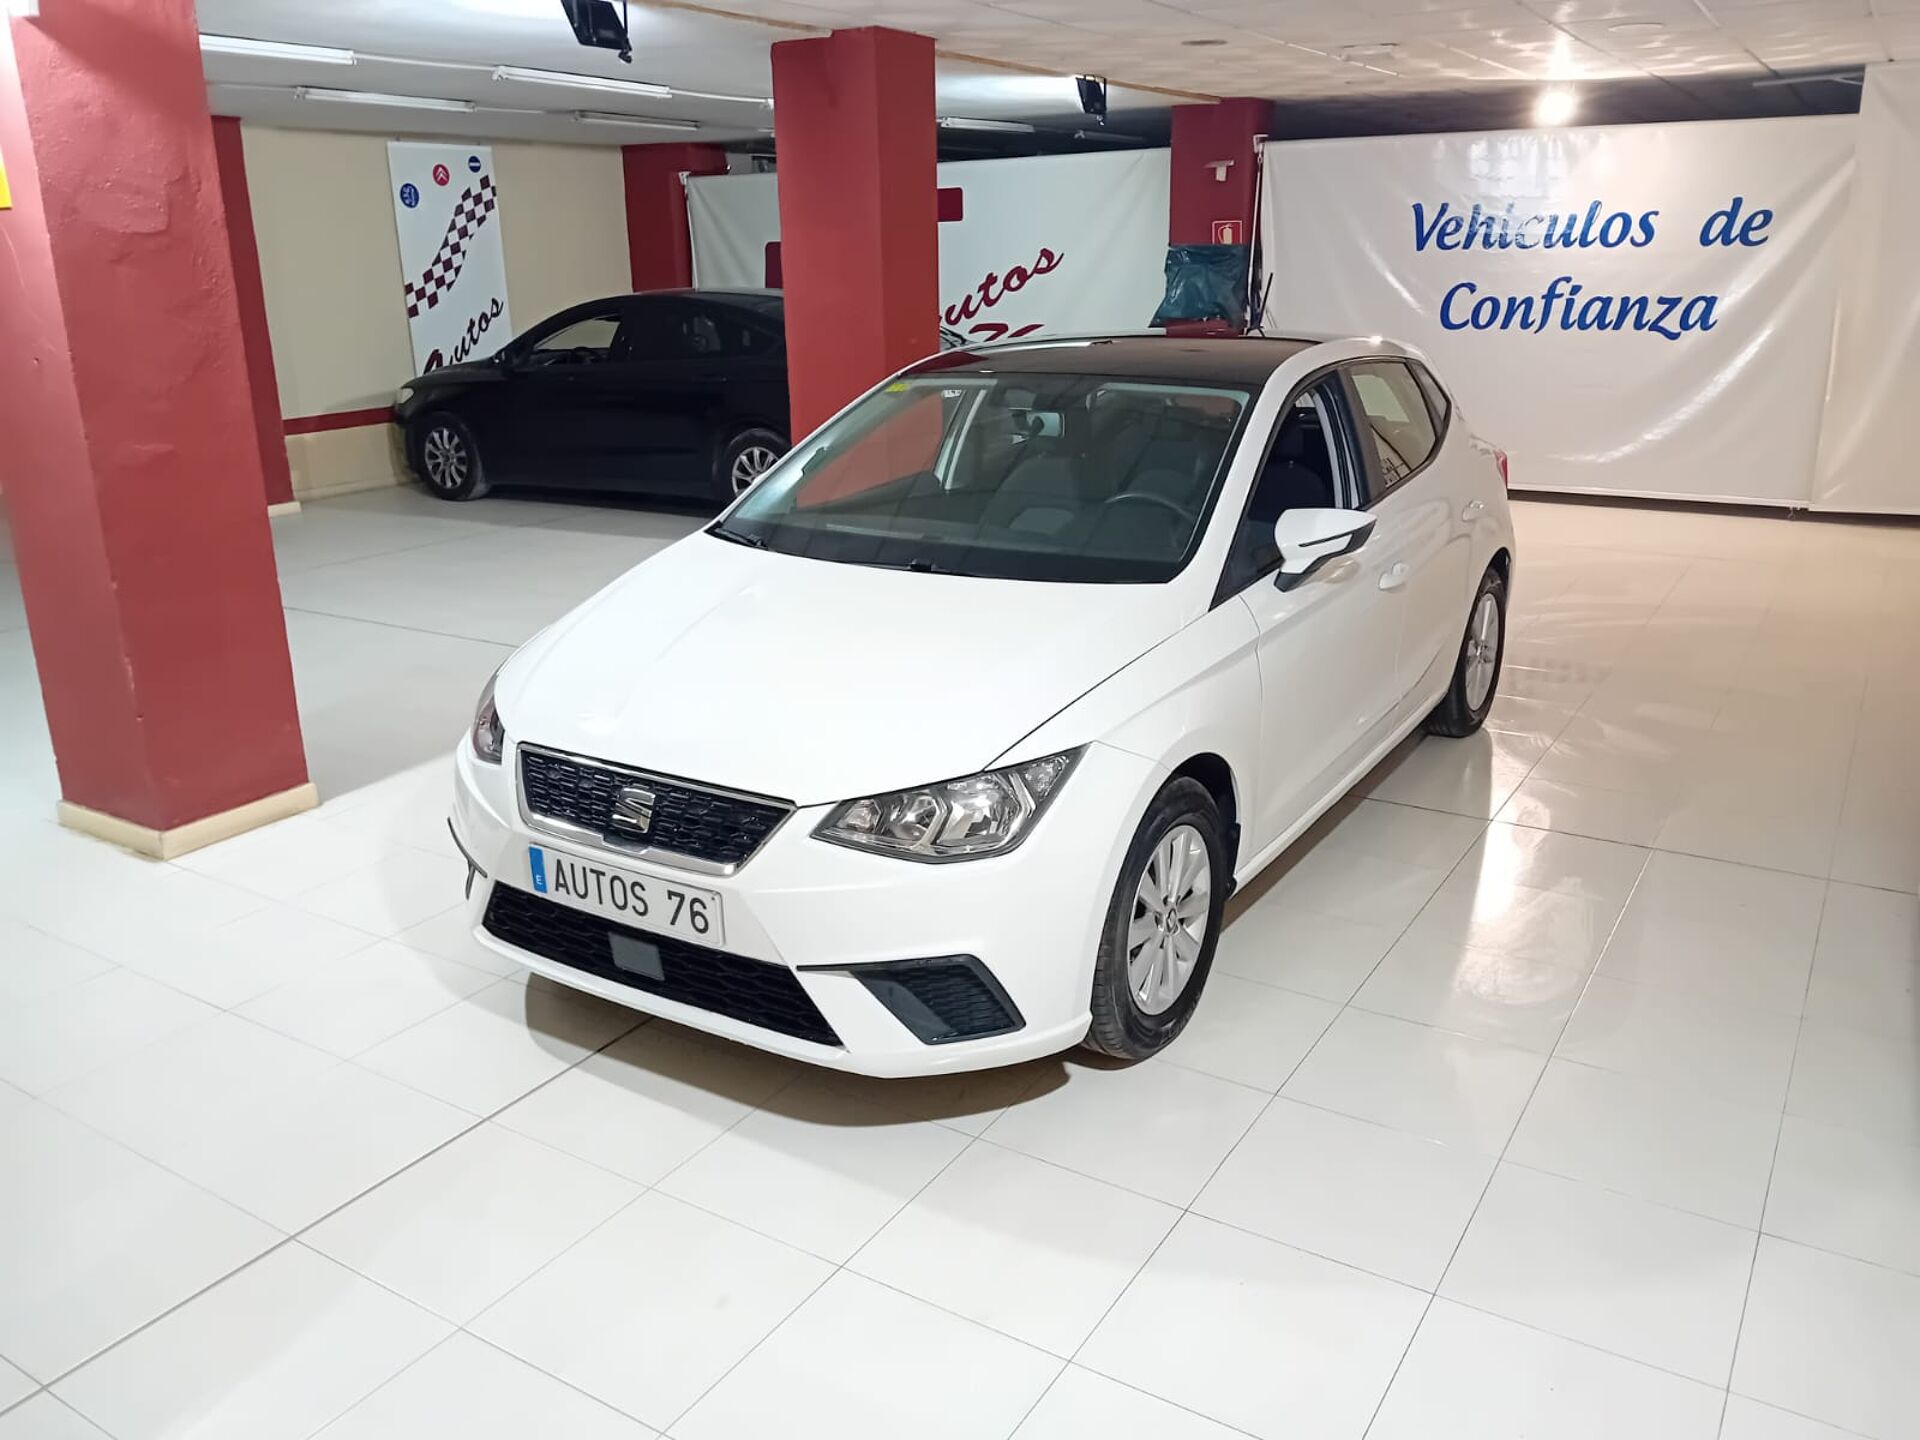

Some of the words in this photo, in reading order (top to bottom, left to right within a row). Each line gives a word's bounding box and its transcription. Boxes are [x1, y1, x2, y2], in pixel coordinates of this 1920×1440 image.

[1700, 197, 1773, 247] de
[939, 247, 1064, 326] utos
[1440, 276, 1719, 341] Confianza
[555, 858, 648, 917] AUTOS
[667, 889, 709, 934] 76
